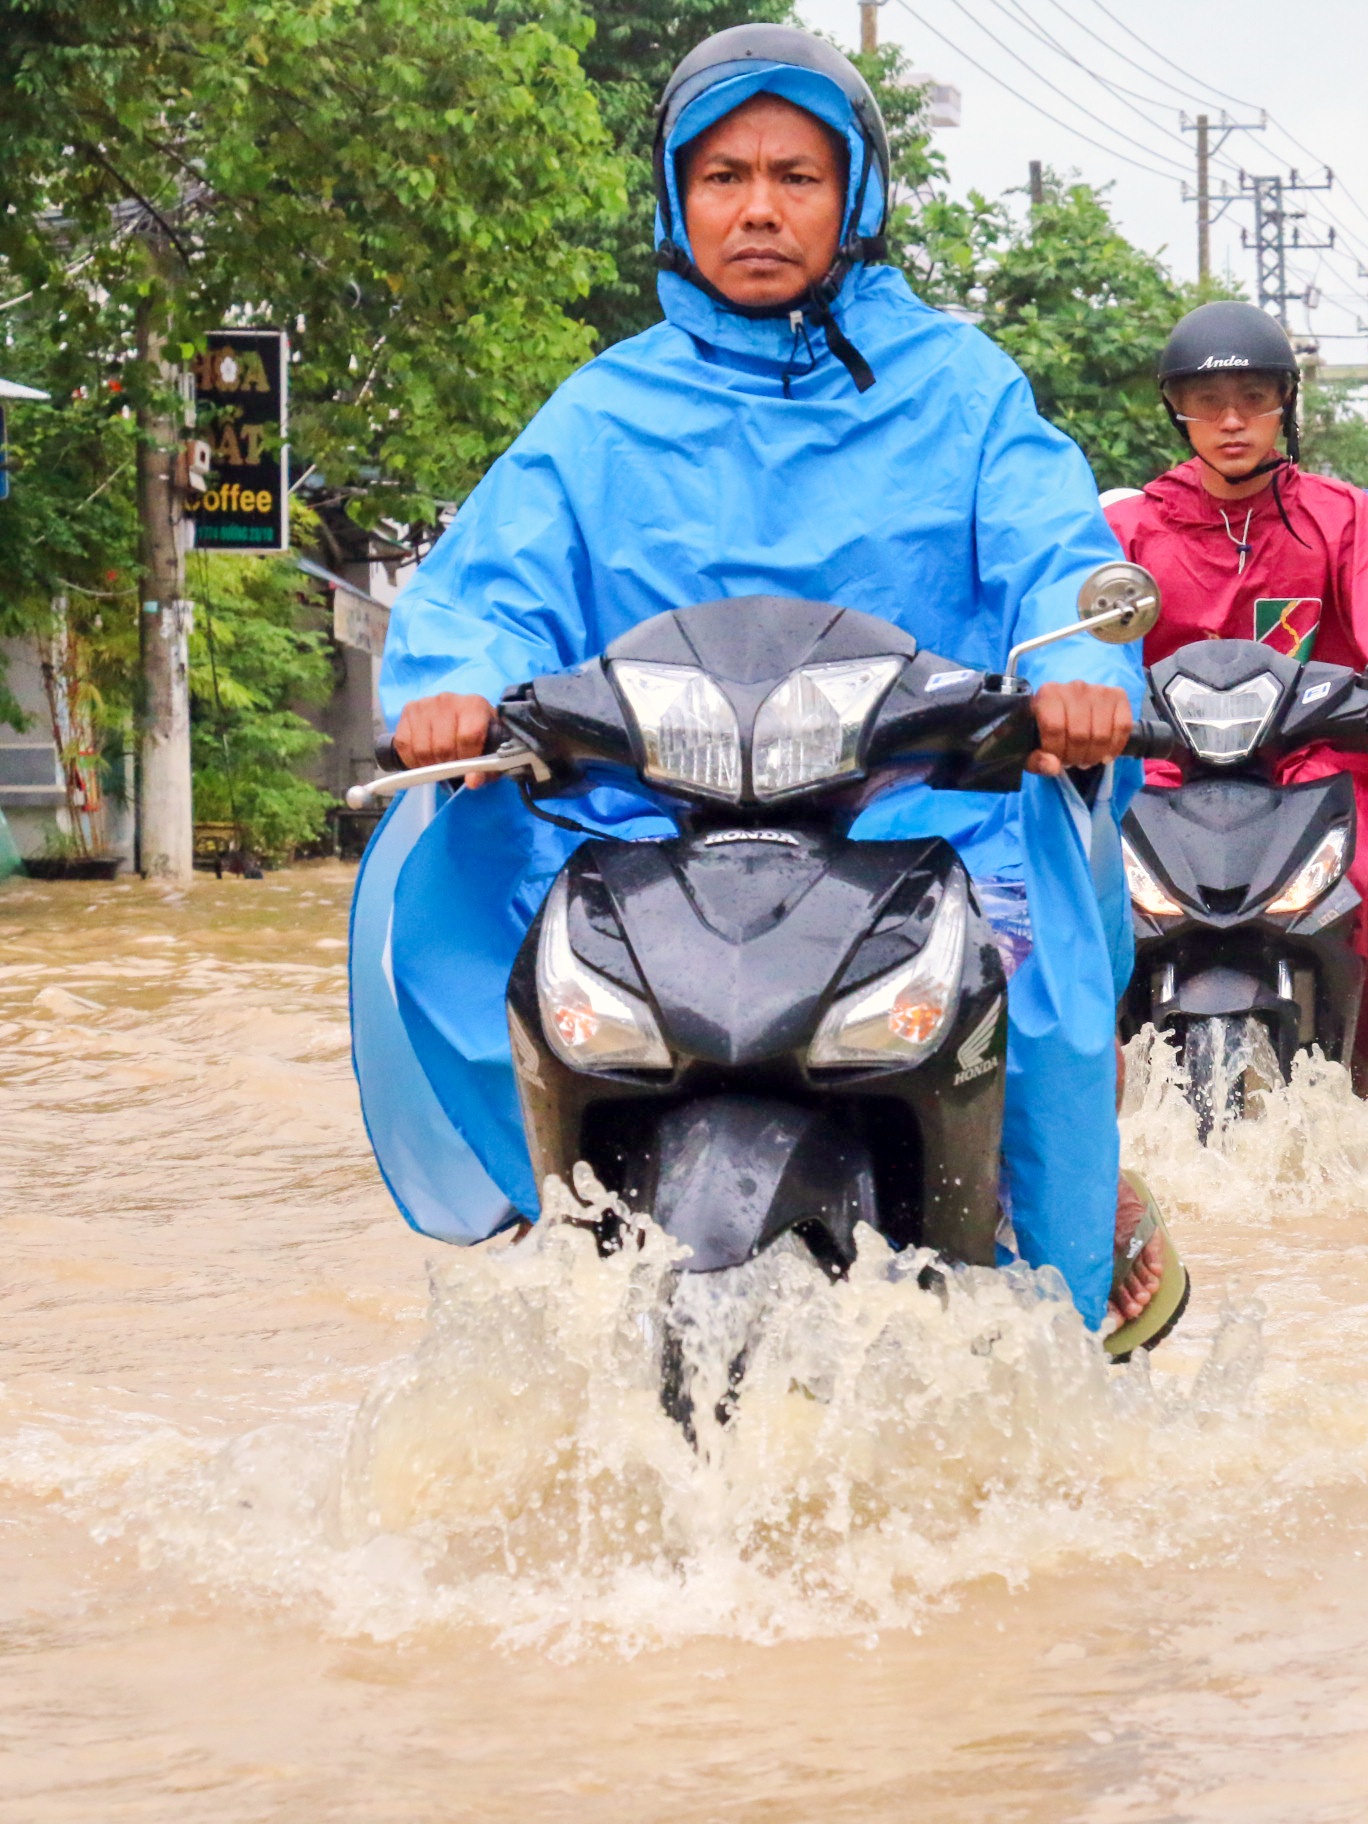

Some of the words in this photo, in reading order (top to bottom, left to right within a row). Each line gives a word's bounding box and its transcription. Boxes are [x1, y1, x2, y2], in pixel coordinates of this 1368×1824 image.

[1197, 355, 1250, 370] Andes
[704, 829, 800, 846] HONDA
[953, 1056, 998, 1086] HONDA
